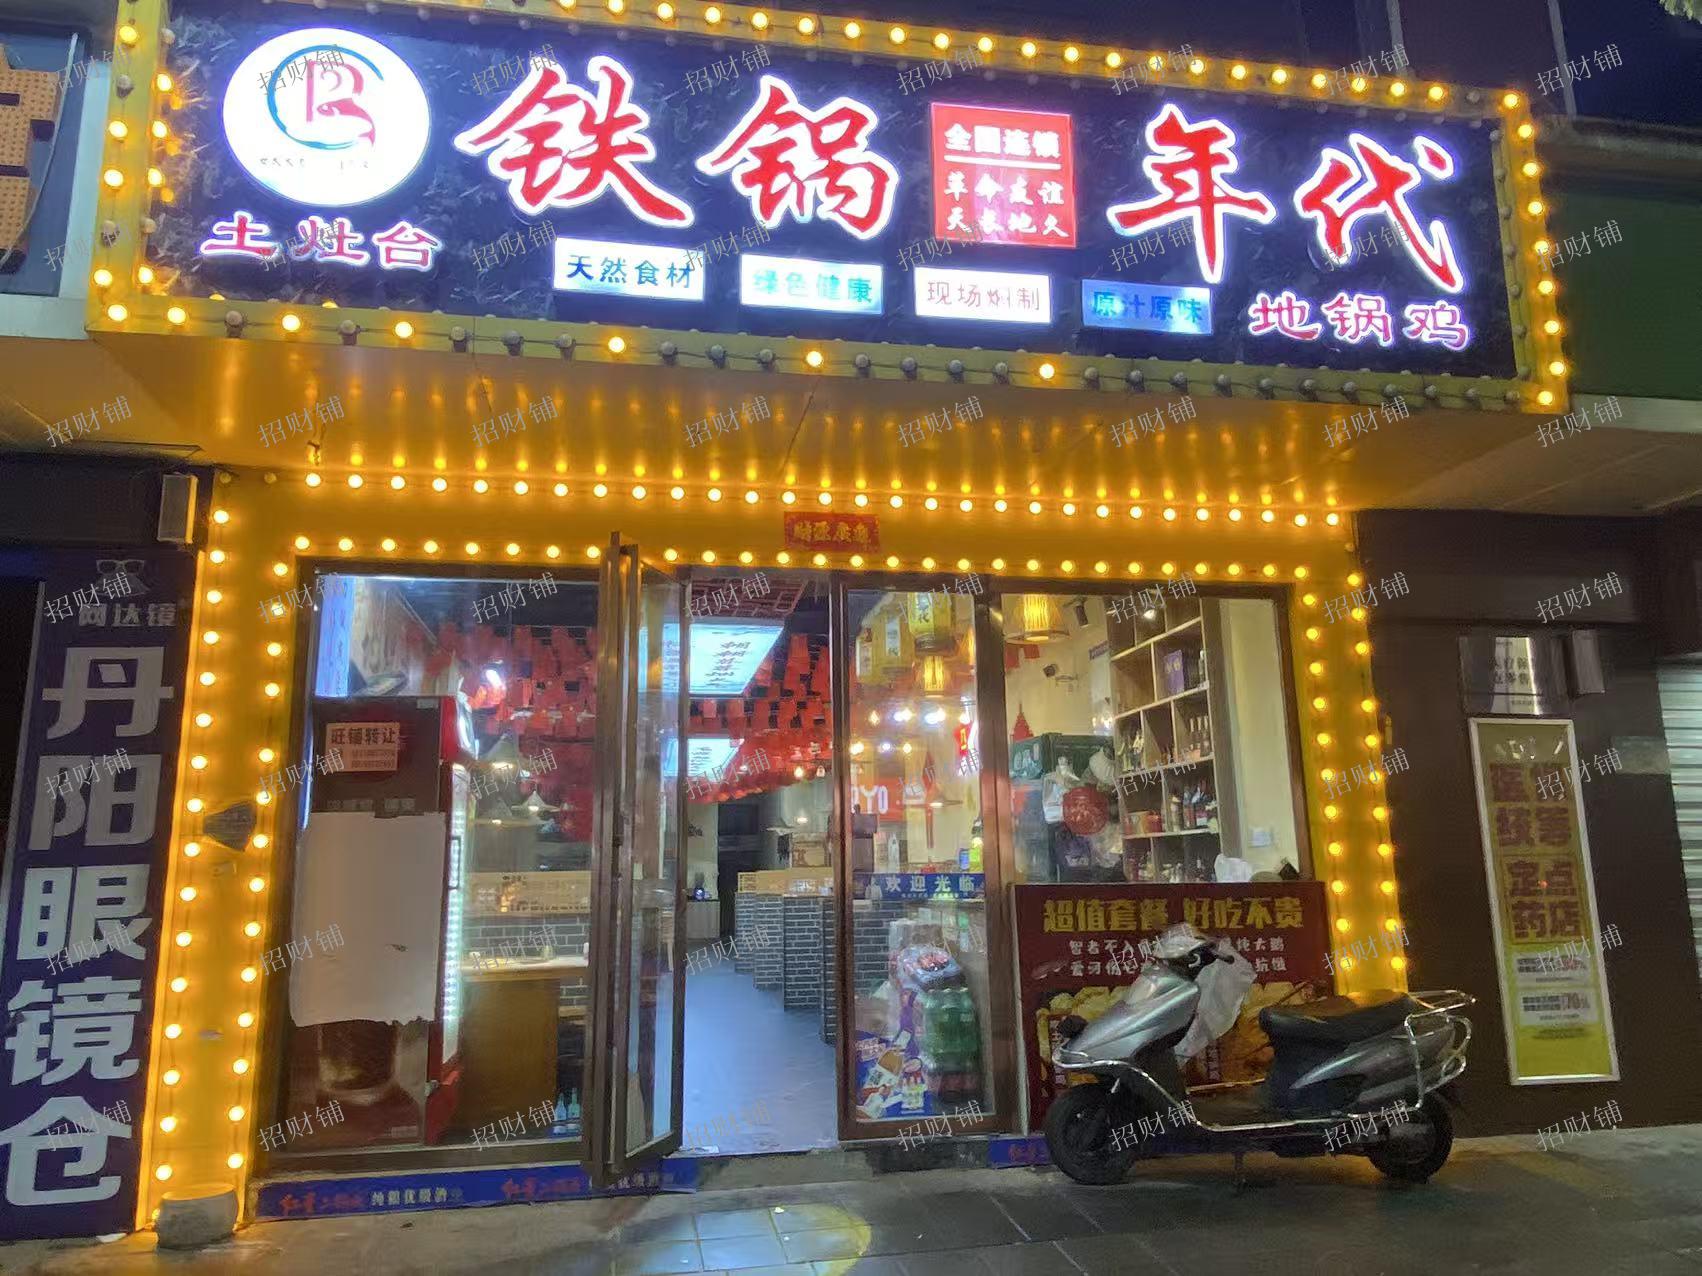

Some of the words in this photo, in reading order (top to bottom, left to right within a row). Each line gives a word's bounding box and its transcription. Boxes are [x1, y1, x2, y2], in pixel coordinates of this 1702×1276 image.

[454, 55, 900, 240] 铁锅
[1106, 104, 1465, 292] 年代
[946, 206, 1069, 237] 天长地久
[200, 211, 443, 272] 土灶台
[566, 254, 692, 290] 天然食材
[752, 269, 874, 304] 绿色健康
[1091, 290, 1204, 325] 原汁原味
[1247, 290, 1472, 350] 地锅鸡
[885, 874, 975, 893] 欢迎光临
[0, 646, 174, 1207] 丹阳眼镜仓
[1043, 898, 1169, 932] 超值套餐
[1182, 897, 1304, 929] 好吃不贵
